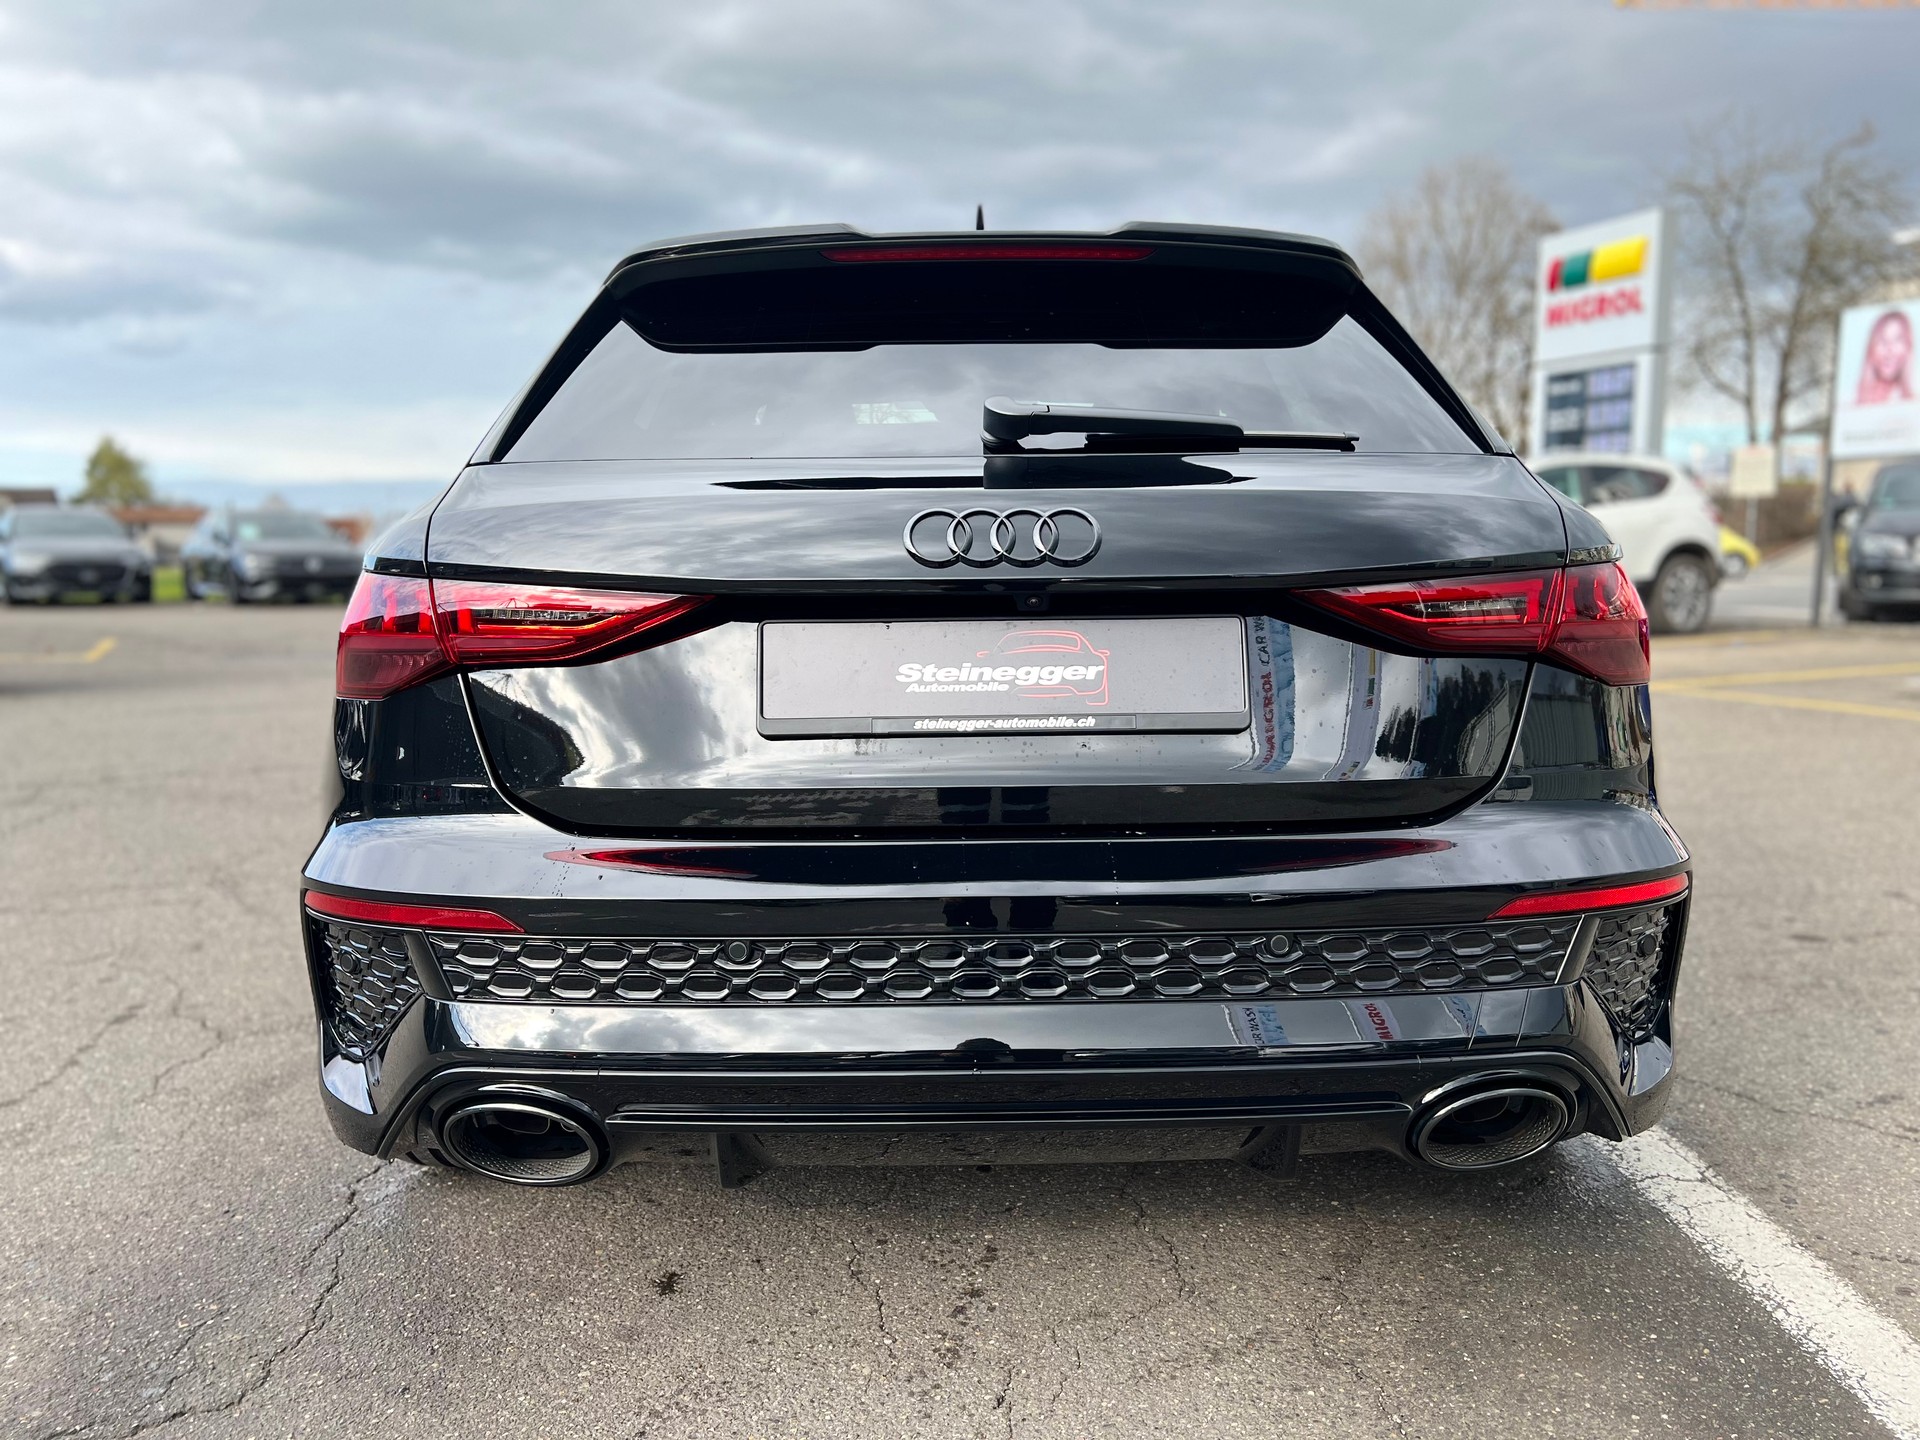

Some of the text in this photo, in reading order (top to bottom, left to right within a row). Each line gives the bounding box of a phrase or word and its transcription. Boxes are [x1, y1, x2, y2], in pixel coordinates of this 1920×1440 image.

[1255, 636, 1271, 665] CAR
[895, 662, 1104, 685] Steinegger
[905, 682, 1010, 693] Automobile
[913, 716, 1096, 731] steinegger-automobile.ch
